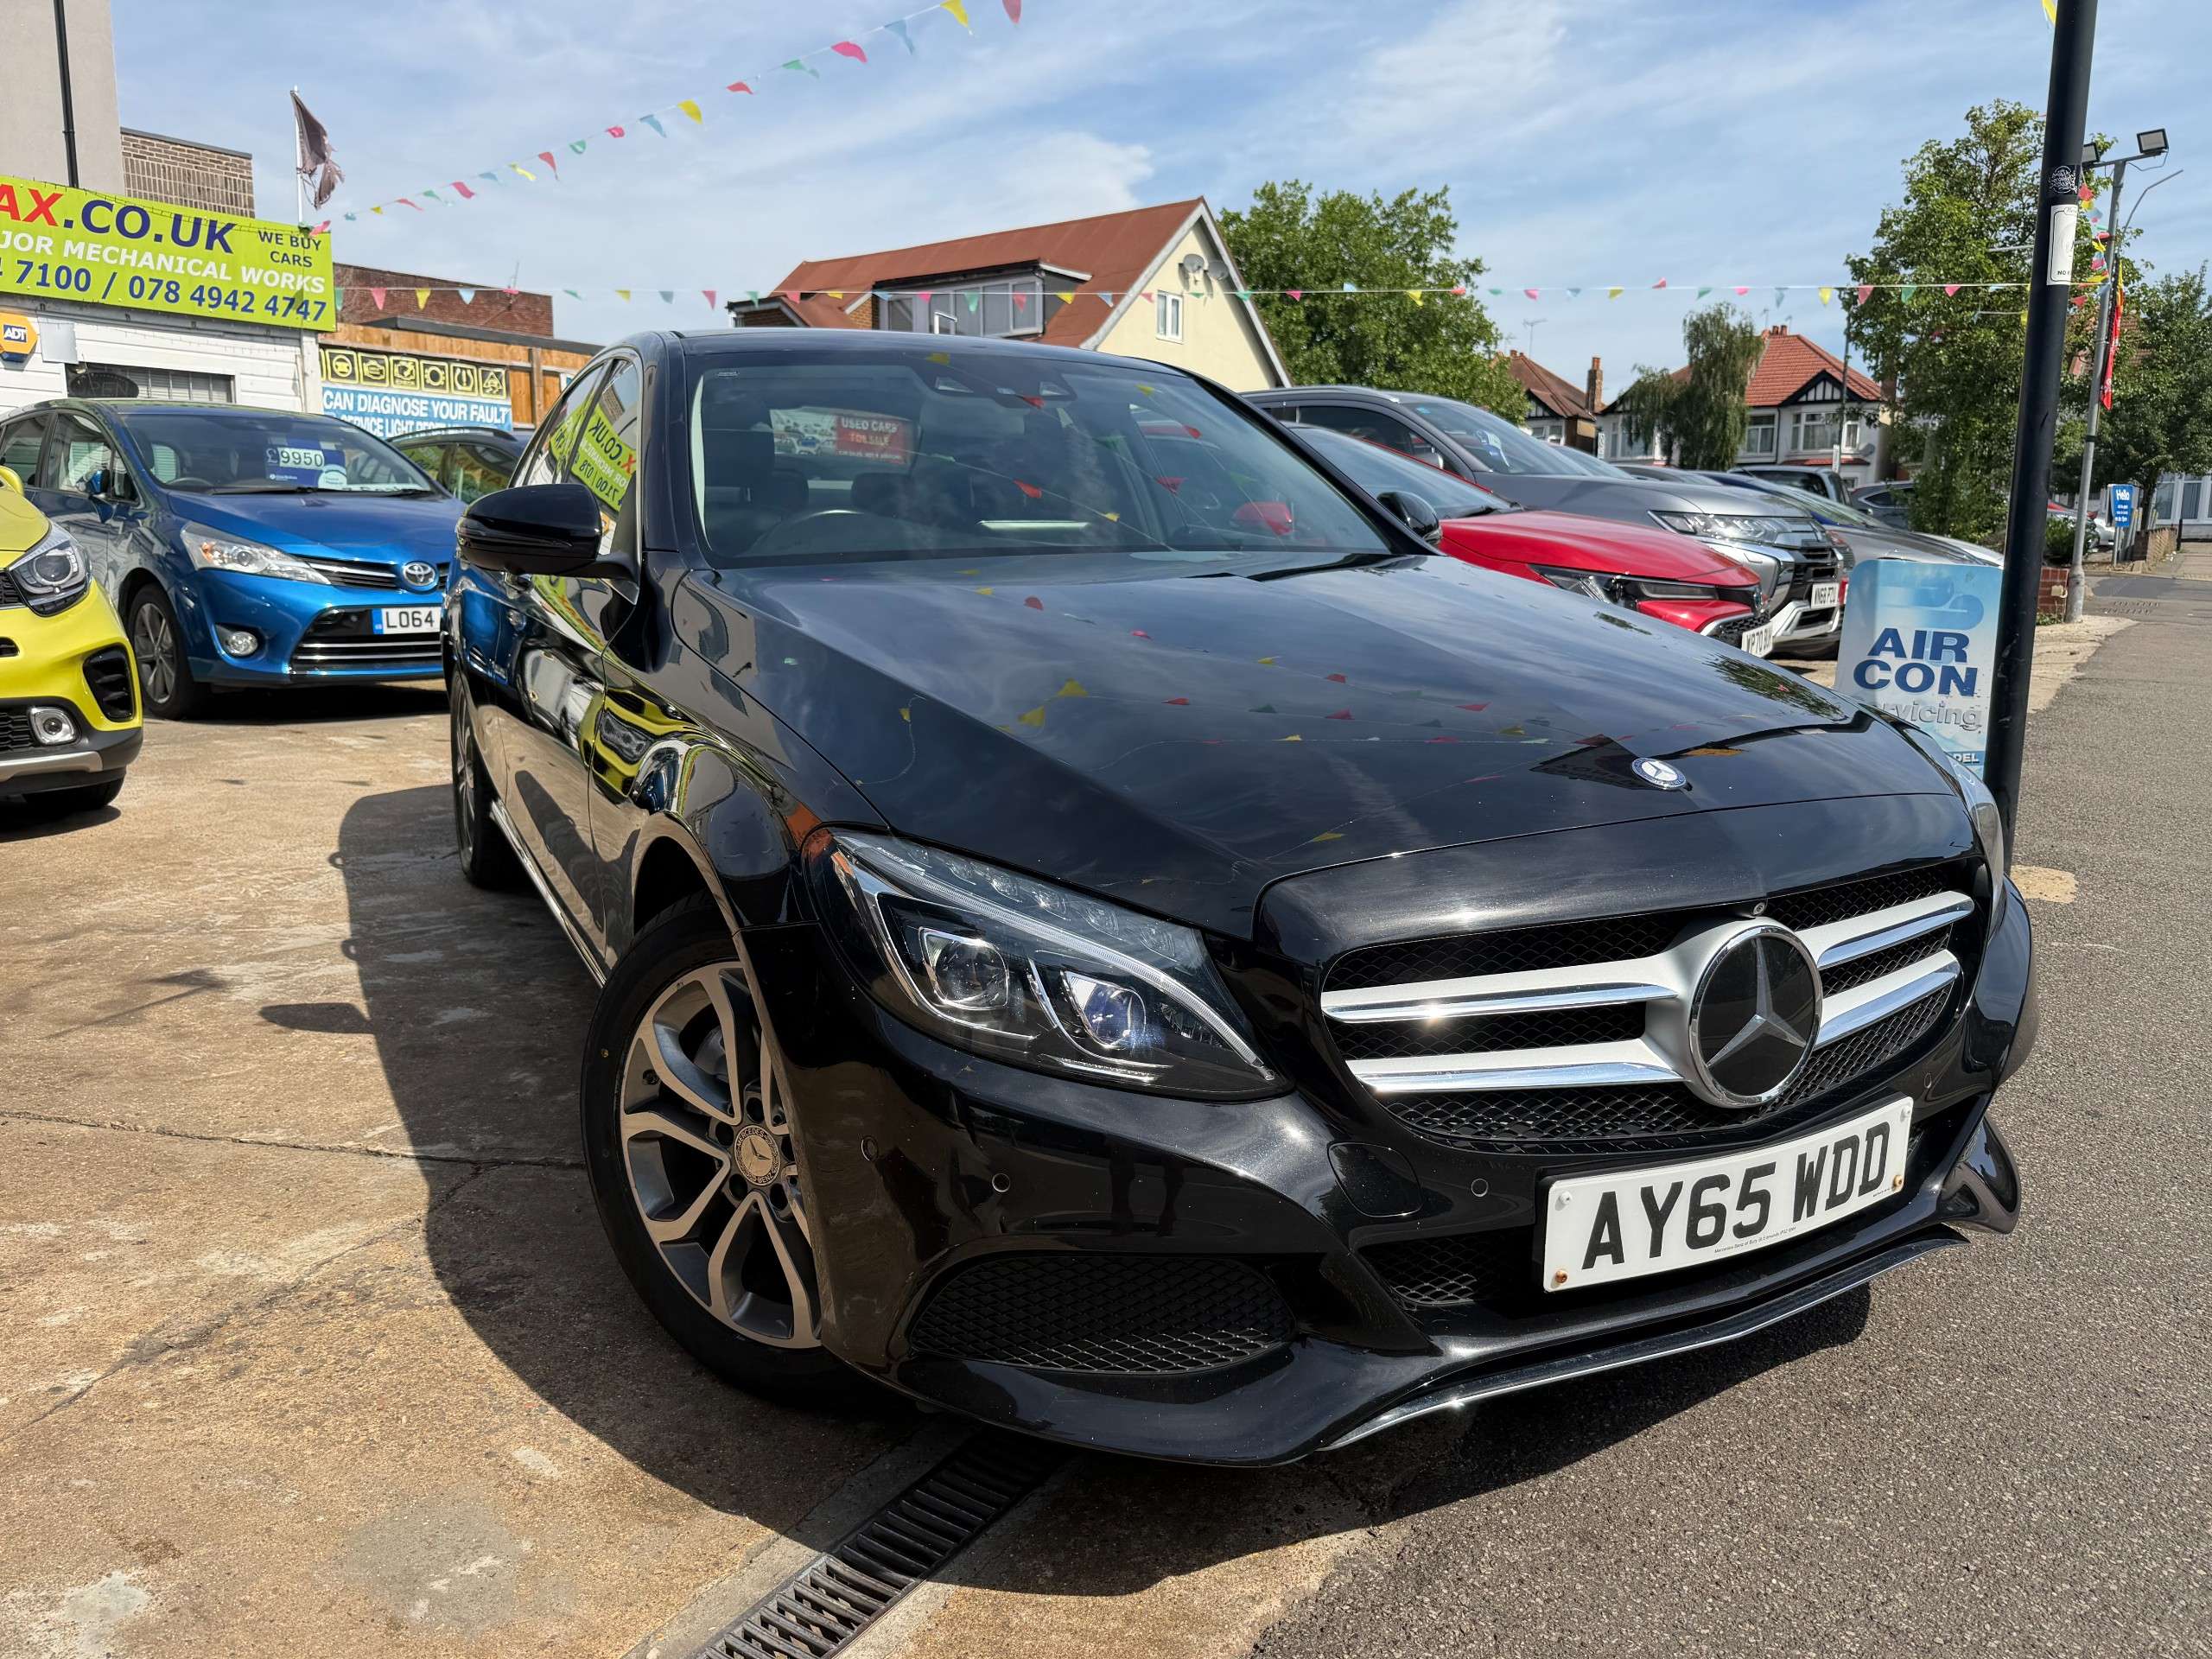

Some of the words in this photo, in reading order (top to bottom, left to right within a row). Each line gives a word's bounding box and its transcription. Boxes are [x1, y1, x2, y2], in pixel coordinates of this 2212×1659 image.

[258, 230, 283, 245] WE
[289, 235, 321, 251] BUY
[63, 239, 232, 281] MECHANICAL
[240, 265, 325, 294] WORKS
[270, 251, 313, 268] CARS
[16, 258, 92, 292] 7100
[128, 275, 181, 304] 078
[190, 284, 256, 314] 4942
[264, 295, 327, 322] 4747
[3, 325, 28, 341] ADT
[322, 390, 354, 411] CAN
[357, 393, 429, 417] DIAGNOSE
[430, 400, 468, 421] YOUR
[469, 404, 509, 424] FAULT
[841, 416, 869, 430] USED
[385, 417, 415, 438] LIGHT
[1866, 627, 1970, 664] AIR
[1853, 658, 1979, 697] CON
[1581, 1160, 1777, 1270] AY65
[1792, 1121, 1891, 1224] WDD
